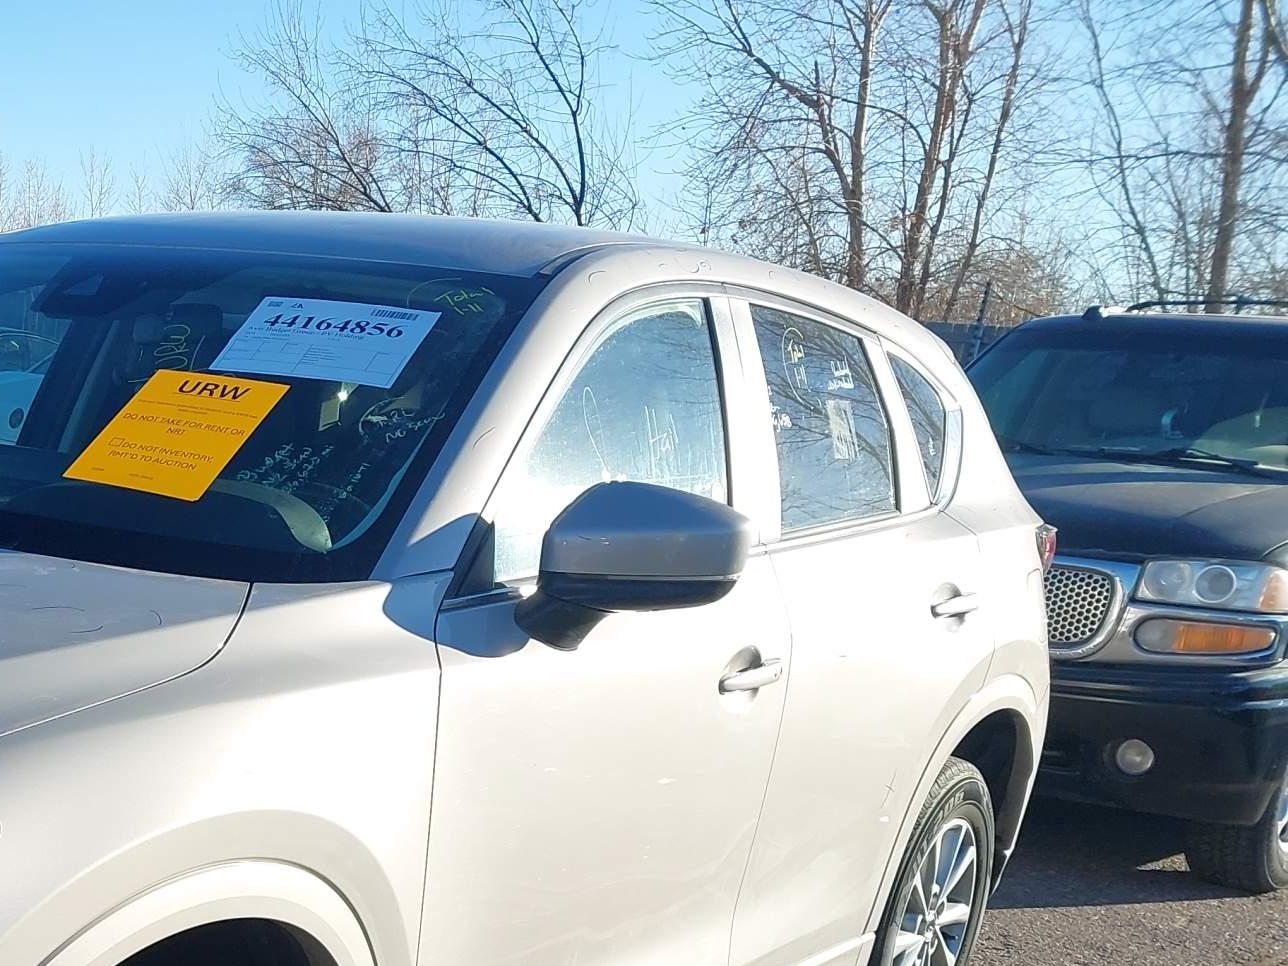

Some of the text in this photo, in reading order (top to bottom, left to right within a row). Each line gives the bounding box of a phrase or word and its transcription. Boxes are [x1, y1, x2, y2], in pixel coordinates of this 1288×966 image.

[264, 313, 410, 339] 44164856
[178, 379, 252, 400] URW
[122, 412, 247, 437] DO NOT TAKE FOR RENT OR
[166, 426, 187, 436] NRT
[122, 440, 137, 449] DO
[137, 442, 159, 453] NOT
[139, 453, 153, 463] TO
[152, 456, 197, 471] AUCTION
